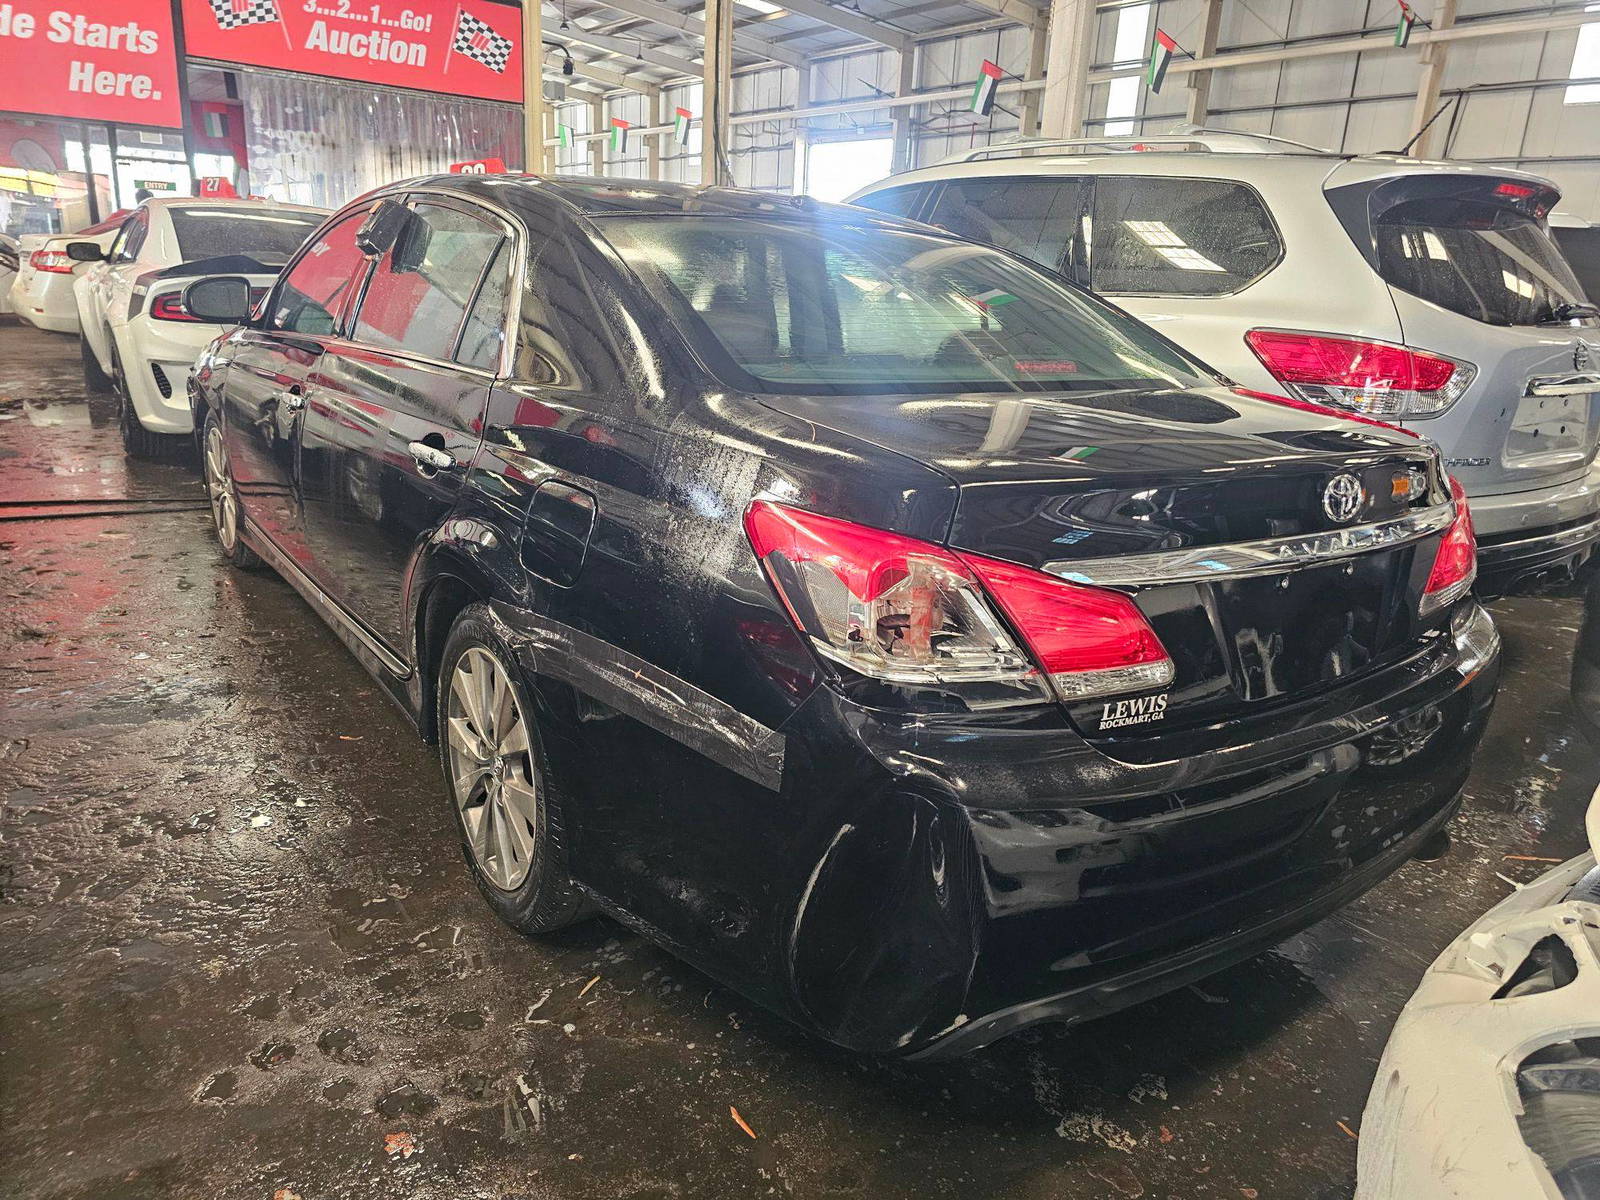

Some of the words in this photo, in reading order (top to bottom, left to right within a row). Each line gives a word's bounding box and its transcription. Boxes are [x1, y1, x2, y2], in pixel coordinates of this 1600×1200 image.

[47, 10, 159, 54] Starts
[304, 20, 427, 67] Auction
[68, 60, 162, 100] Here.
[144, 181, 169, 190] ENTRY
[206, 178, 220, 192] 27
[1100, 693, 1168, 720] LEWIS
